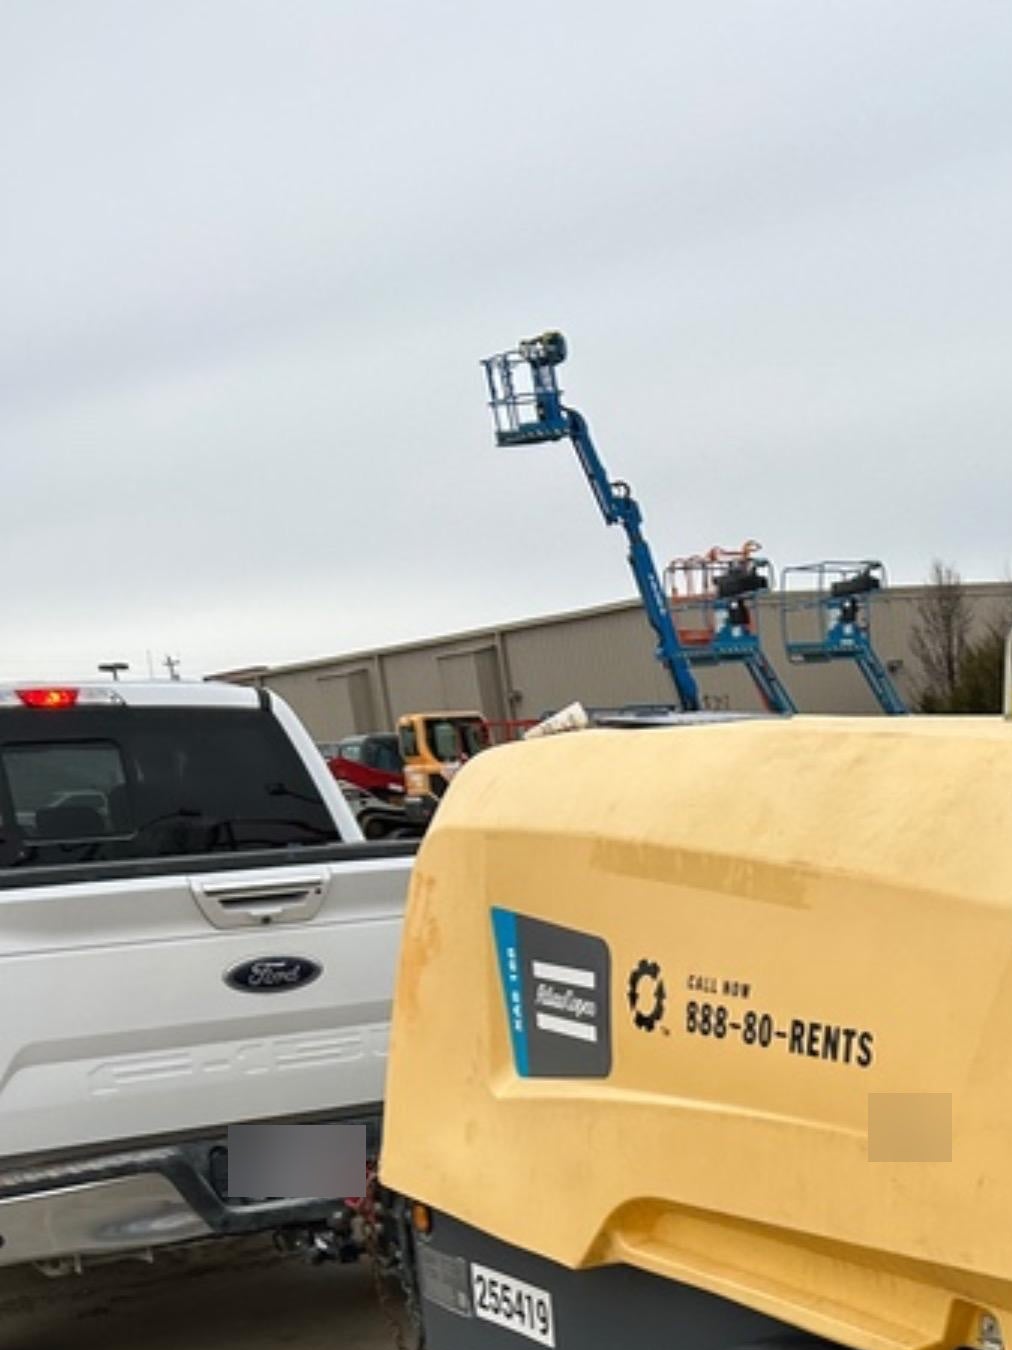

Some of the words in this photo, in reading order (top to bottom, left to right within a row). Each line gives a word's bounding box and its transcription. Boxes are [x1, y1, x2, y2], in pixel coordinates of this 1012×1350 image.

[248, 960, 302, 985] Ford
[686, 974, 718, 994] CALL
[722, 980, 751, 999] NOW
[686, 1000, 874, 1068] 888-80-RENTS
[474, 1273, 551, 1336] 255419
